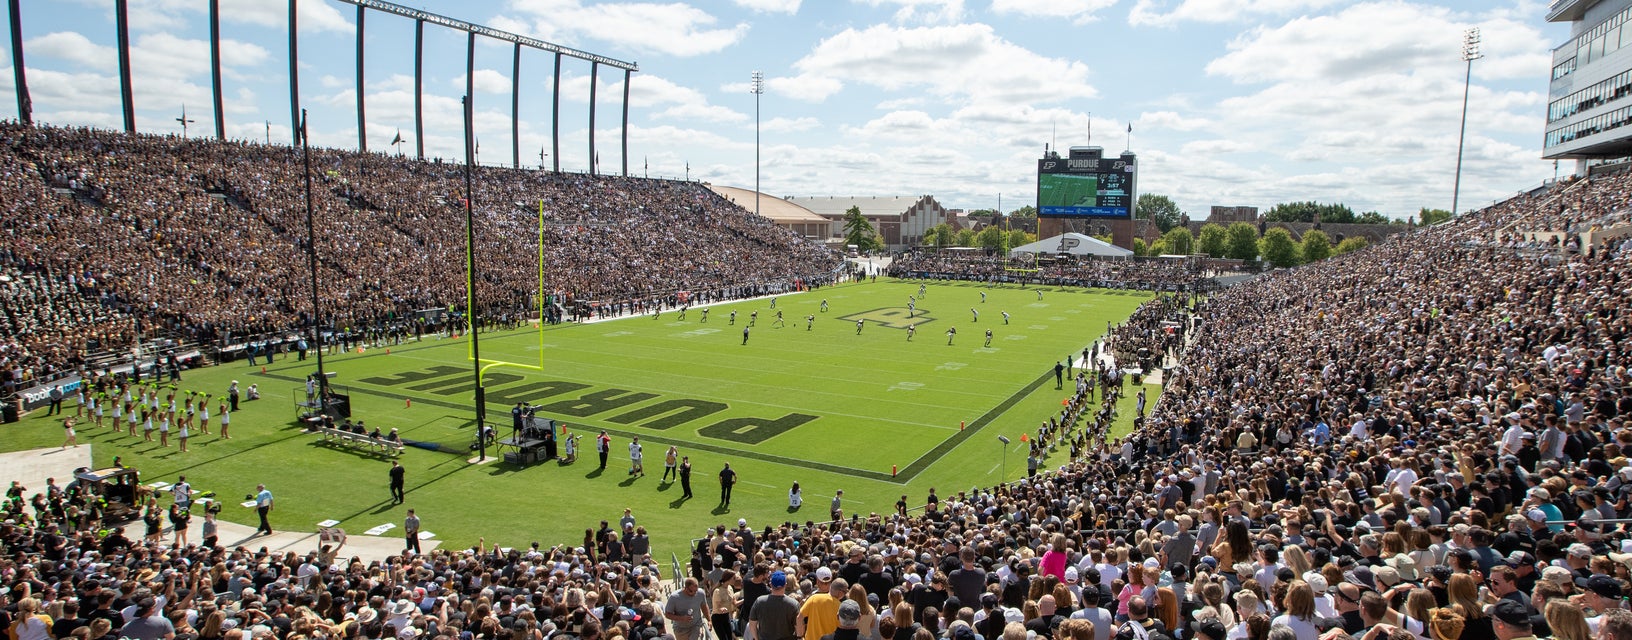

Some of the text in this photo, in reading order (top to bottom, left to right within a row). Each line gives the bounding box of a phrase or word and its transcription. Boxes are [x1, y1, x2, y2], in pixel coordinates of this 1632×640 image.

[1067, 159, 1099, 168] PURDUE
[1056, 237, 1081, 251] P
[357, 364, 820, 445] PURDUE
